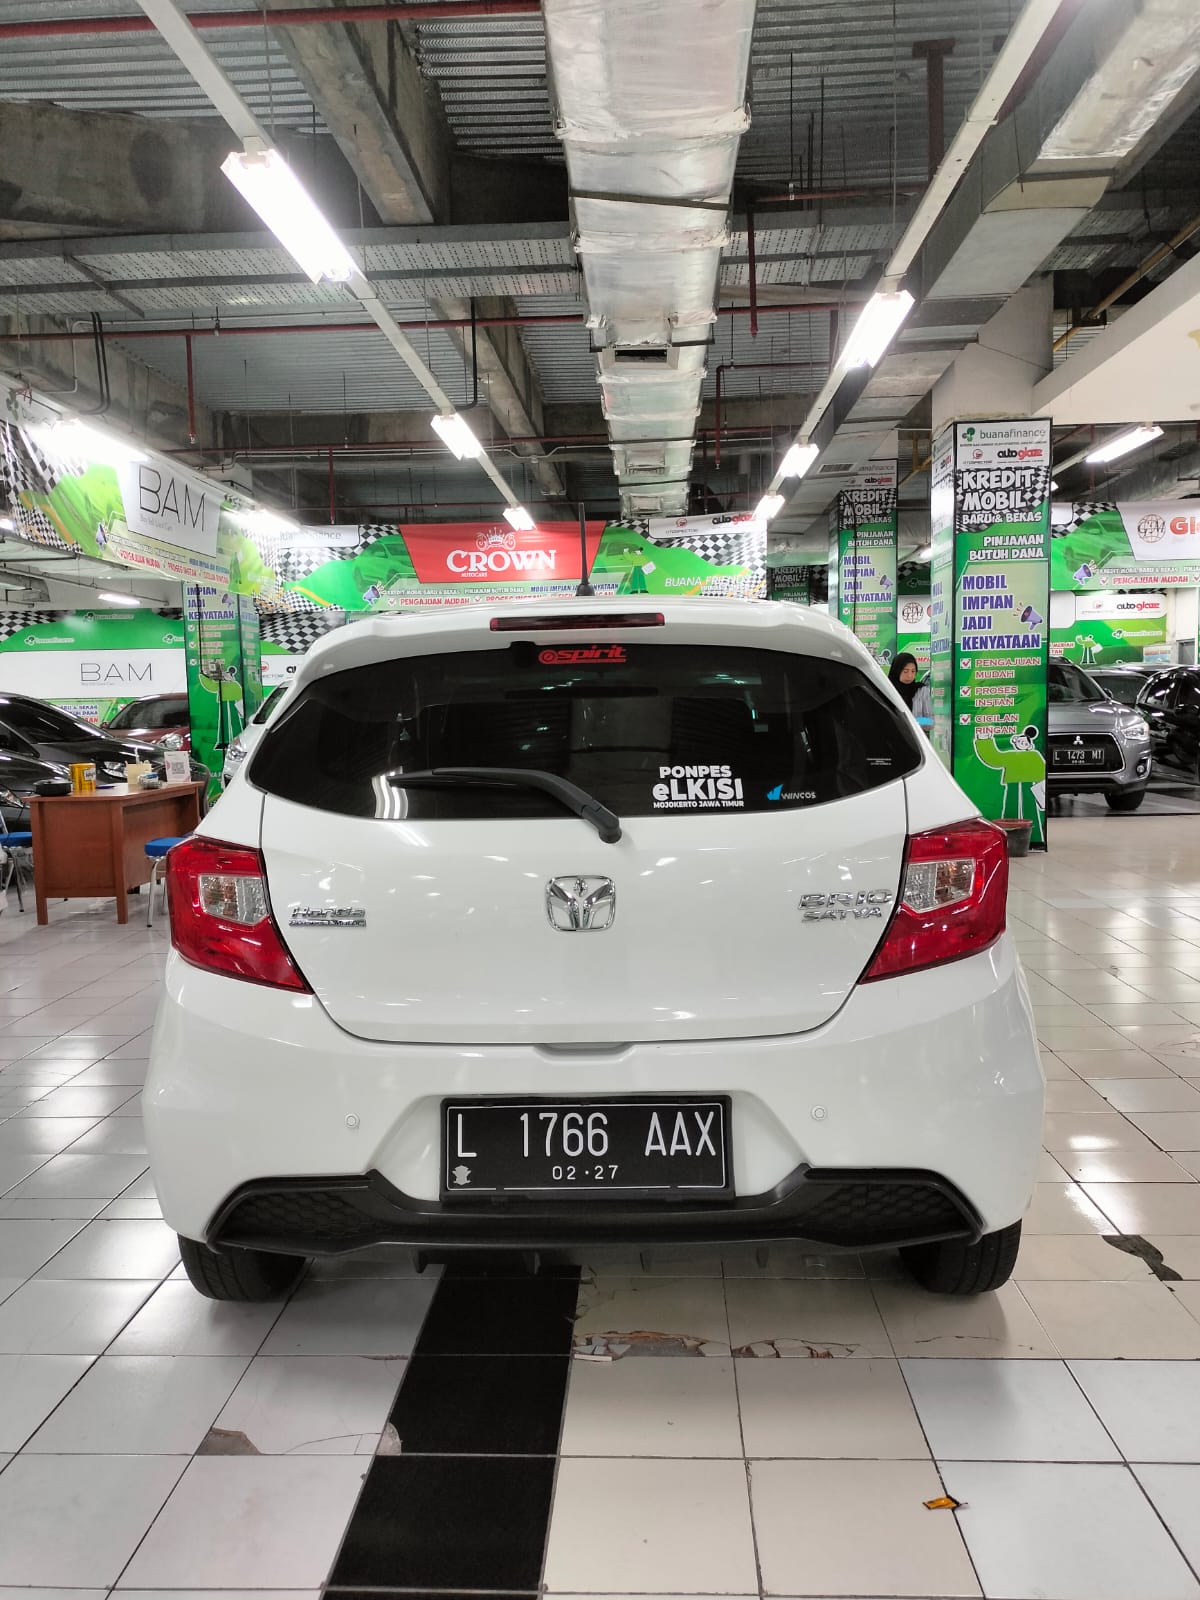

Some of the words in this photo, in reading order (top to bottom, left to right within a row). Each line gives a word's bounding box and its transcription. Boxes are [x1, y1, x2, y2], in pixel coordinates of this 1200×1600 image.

[980, 429, 1046, 439] buanafinance
[962, 469, 1035, 490] KREDIT
[139, 464, 206, 533] BAM
[844, 490, 888, 503] KREDIT
[962, 490, 1026, 511] MOBIL
[843, 504, 883, 516] MOBIL
[962, 513, 991, 525] BARU
[994, 513, 1003, 524] &
[1006, 511, 1042, 522] BEKAS
[983, 534, 1044, 547] PINJAMAN
[969, 549, 1009, 560] BUTUH
[1011, 547, 1044, 559] DANA
[446, 550, 557, 573] CROWN
[843, 556, 872, 565] MOBIL
[844, 568, 875, 578] IMPIAN
[665, 577, 702, 587] BUANA
[962, 575, 1007, 590] MOBIL
[1112, 577, 1159, 585] PENGAJUAN
[187, 587, 217, 596] IMPIAN
[400, 598, 442, 606] PENGAJUAN
[844, 593, 892, 602] KENYATAAN
[962, 594, 1013, 610] IMPIAN
[189, 611, 234, 620] KENYATAAN
[962, 616, 992, 630] JADI
[962, 634, 1041, 650] KENYATAAN
[975, 658, 1041, 667] PENGAJUAN
[80, 662, 153, 682] BAM
[975, 670, 1015, 679] MUDAH
[975, 686, 1017, 694] PROSES
[975, 698, 1014, 706] INSTAN
[975, 714, 1019, 722] CICILAN
[975, 725, 1016, 734] RINGAN
[1055, 751, 1060, 760] L
[1067, 751, 1085, 760] 1473
[659, 765, 732, 778] PONPES
[652, 778, 744, 801] eLKISI
[781, 791, 817, 800] WINCOS
[722, 800, 745, 808] TIMUR
[800, 890, 893, 908] BRIO
[457, 1113, 477, 1157] L
[519, 1112, 609, 1157] 1766
[644, 1111, 716, 1157] AAX
